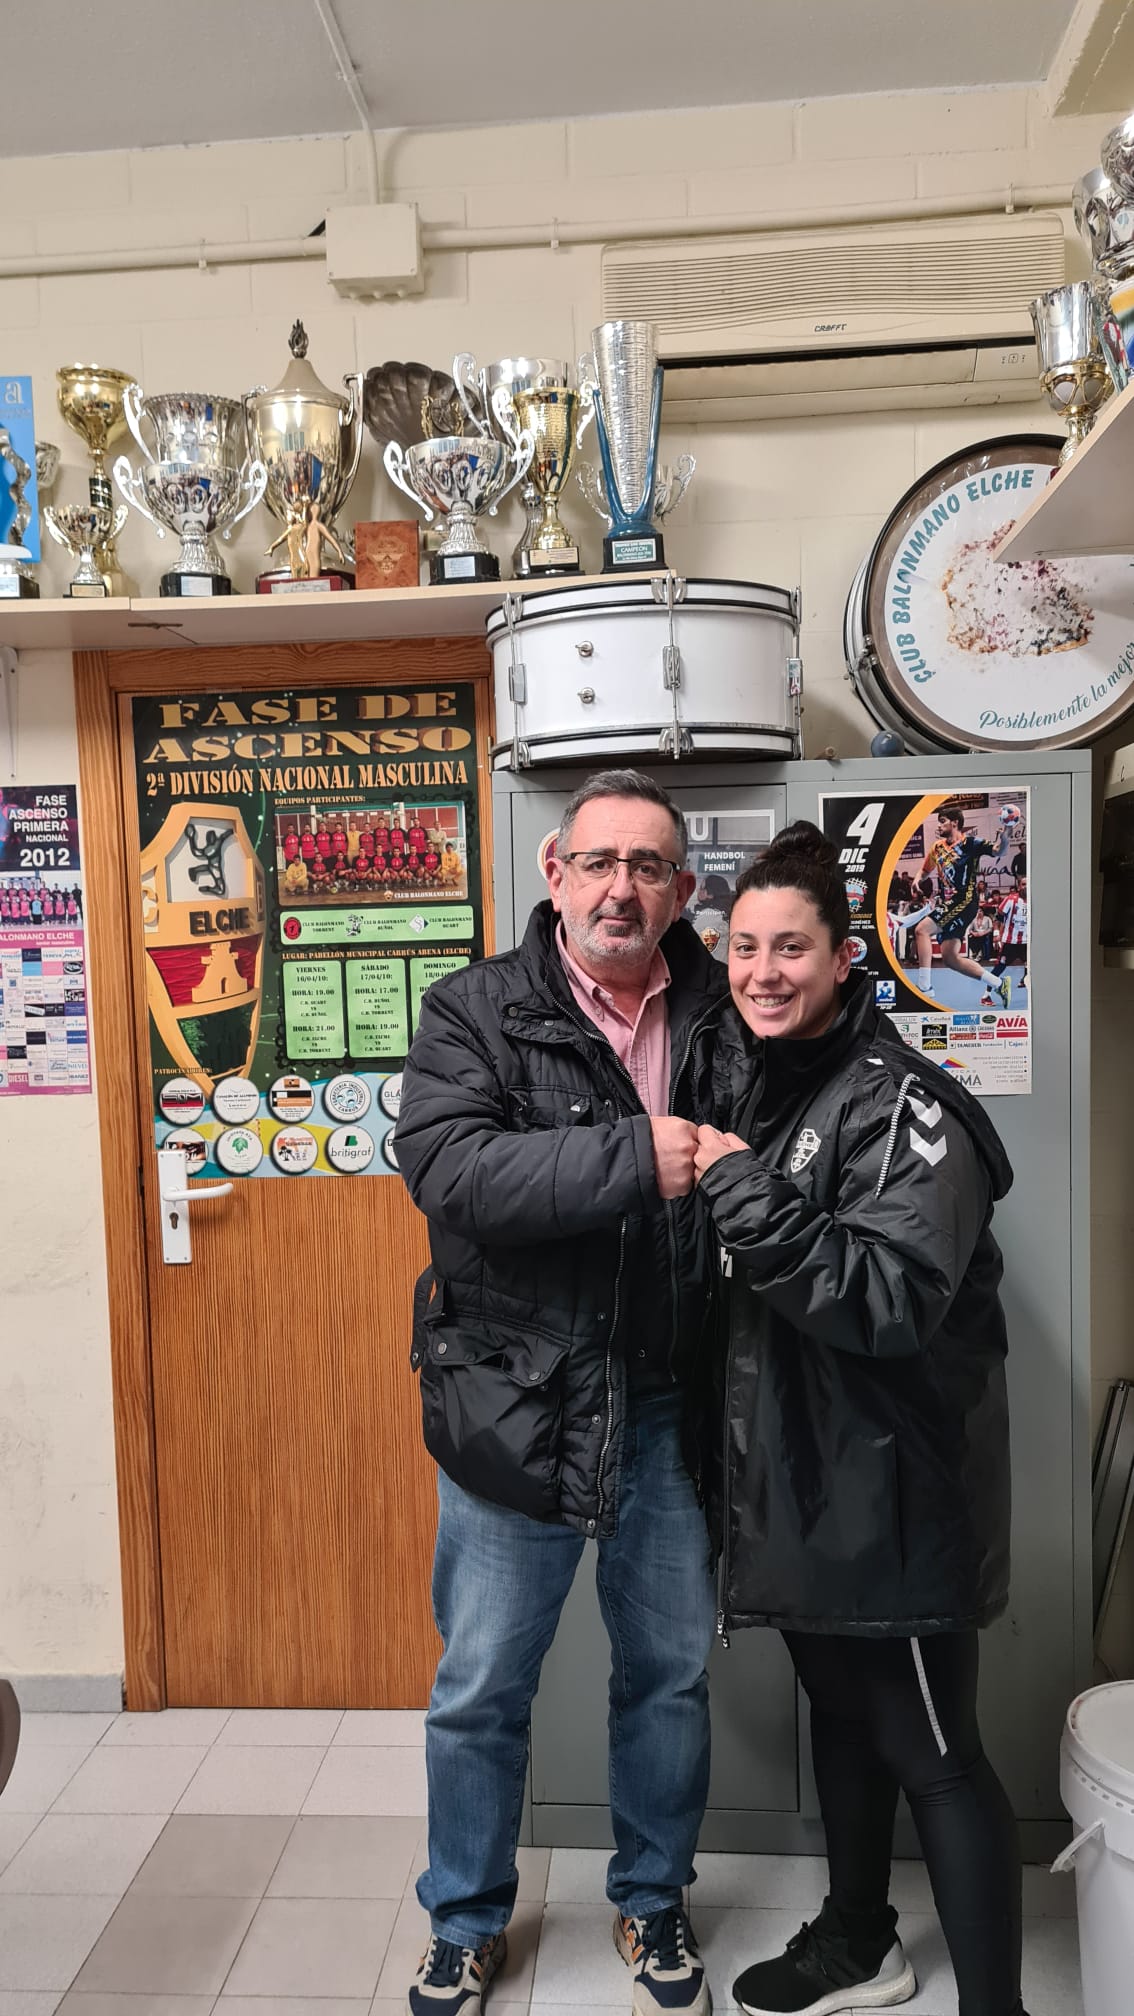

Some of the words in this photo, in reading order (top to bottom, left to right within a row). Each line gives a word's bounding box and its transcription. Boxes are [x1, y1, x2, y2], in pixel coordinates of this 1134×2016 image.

[966, 469, 1034, 502] ELCHE
[892, 493, 961, 625] BALONMANO
[896, 632, 937, 684] CLUB
[159, 696, 338, 728] FASE
[356, 692, 457, 720] DE
[980, 693, 1091, 729] Posiblemente
[1090, 684, 1108, 701] la
[142, 726, 472, 763] ASCENSO
[146, 772, 165, 797] 2ª
[169, 763, 254, 796] DIVISIÓN
[259, 764, 354, 793] NACIONAL
[358, 760, 469, 788] MASCULINA
[35, 794, 68, 806] FASE
[274, 796, 304, 806] EQUIPOS
[306, 795, 366, 804] PARTICIPANTES:
[9, 808, 68, 820] ASCENSO
[14, 820, 70, 833] PRIMERA
[845, 803, 885, 845] 4
[26, 834, 69, 843] NACIONAL
[20, 848, 71, 868] 2012
[704, 852, 746, 860] HANDBOL
[838, 848, 870, 864] DIC
[704, 862, 736, 872] FEMENÍ
[845, 864, 865, 873] 2019
[394, 891, 409, 899] CLUB
[189, 907, 250, 937] ELCHE
[0, 932, 45, 940] ALONMANO
[282, 952, 308, 960] LUGAR:
[308, 950, 346, 959] PABELLÓN
[386, 948, 416, 956] CARRÚS
[442, 947, 472, 955] (ELCHE)
[996, 1016, 1028, 1028] AVÍA
[331, 1147, 372, 1158] britigraf
